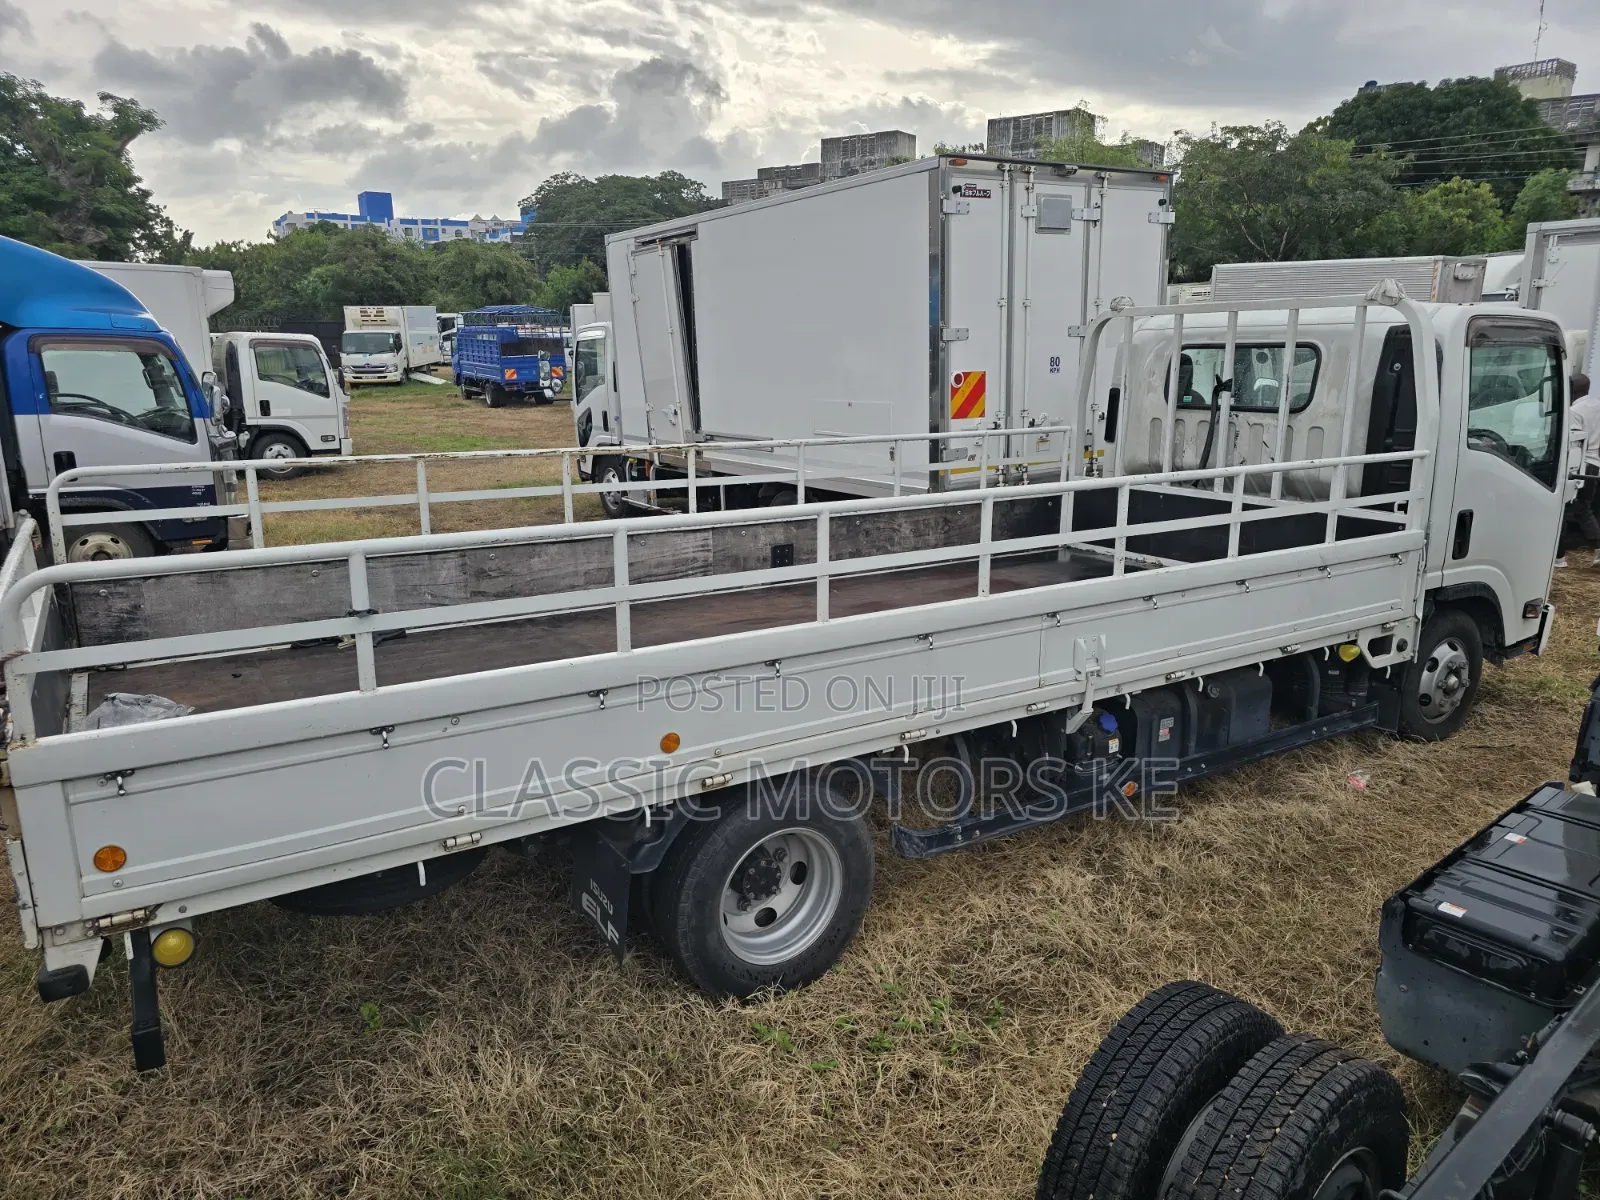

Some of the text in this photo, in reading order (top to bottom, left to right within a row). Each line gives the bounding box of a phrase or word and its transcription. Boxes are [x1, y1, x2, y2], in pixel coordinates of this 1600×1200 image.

[1050, 356, 1060, 366] 80
[590, 878, 613, 915] ISUZU
[581, 892, 619, 945] ELF
